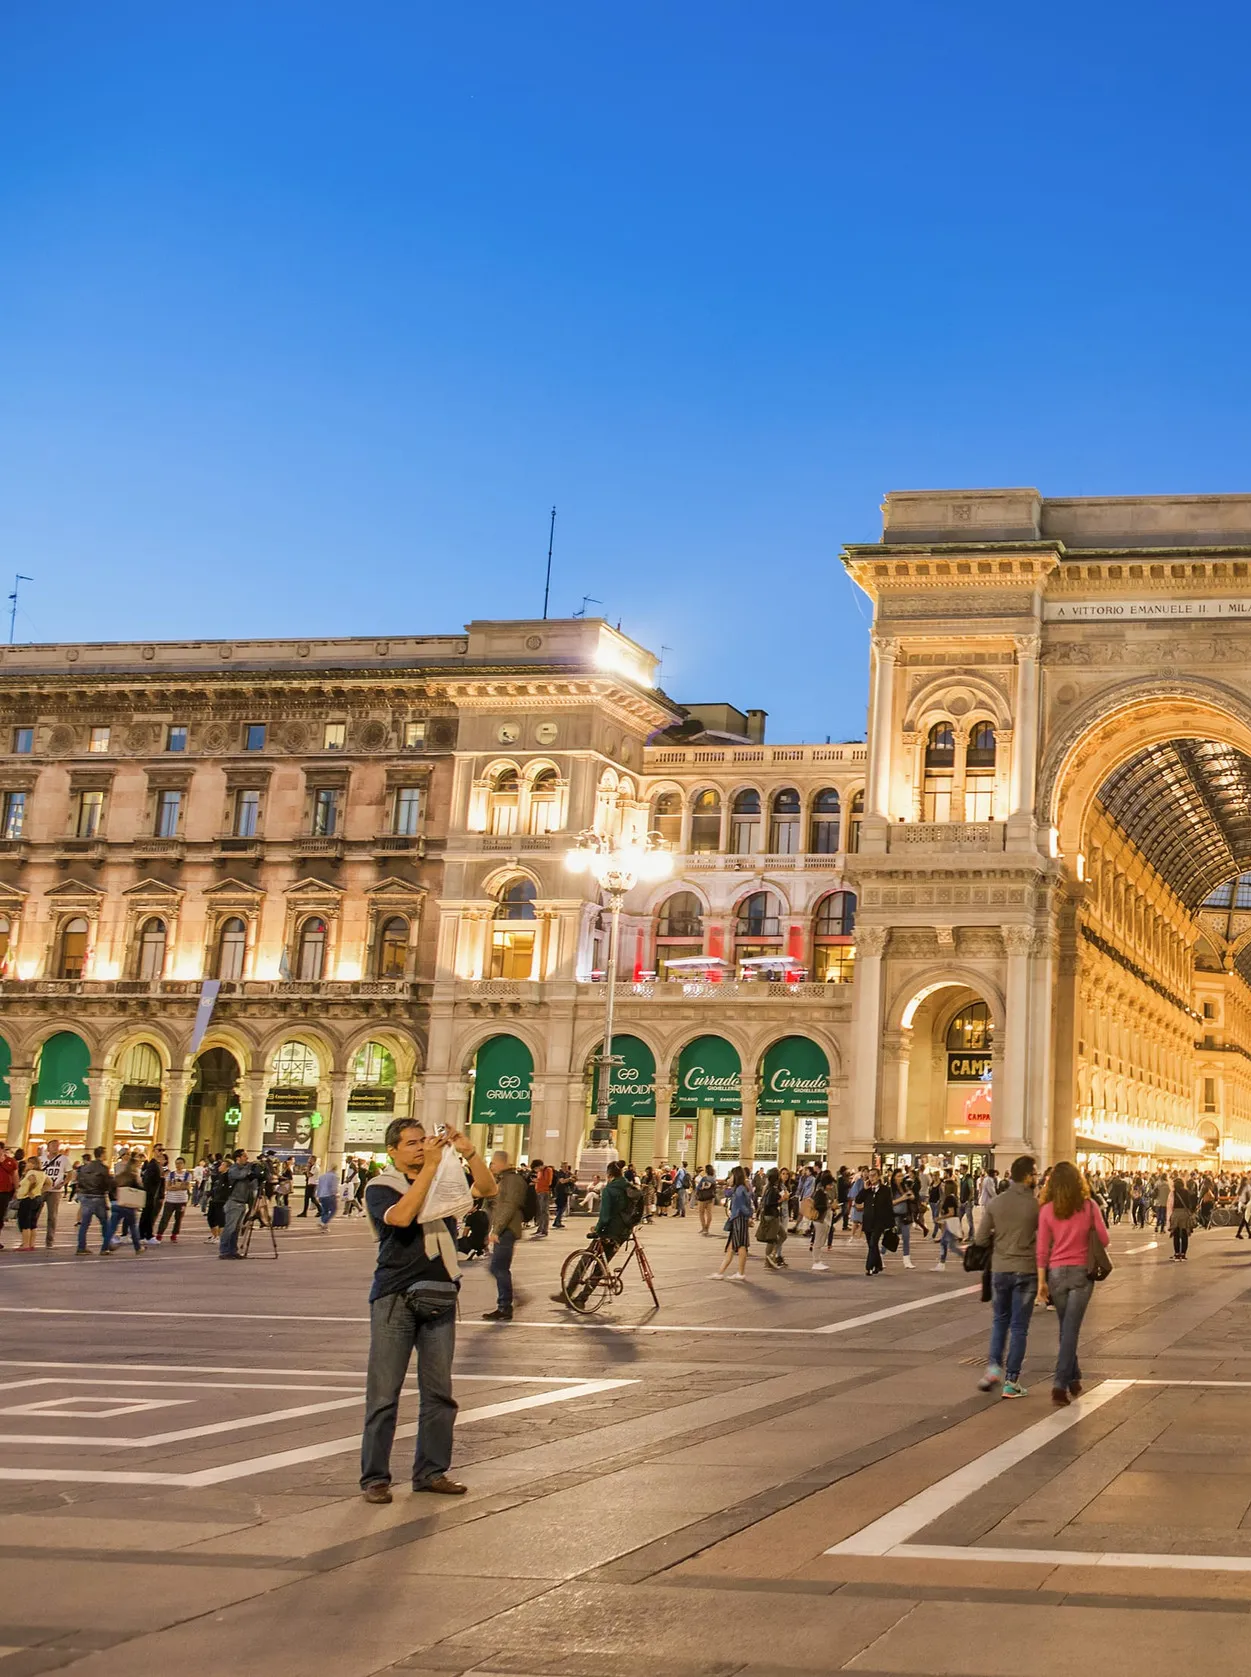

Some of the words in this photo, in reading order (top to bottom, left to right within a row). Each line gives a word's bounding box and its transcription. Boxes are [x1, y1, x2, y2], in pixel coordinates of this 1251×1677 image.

[1058, 608, 1065, 616] A
[1073, 606, 1124, 615] VITTORIO
[1130, 605, 1192, 614] EMANUELE
[684, 1066, 740, 1090] Currado
[770, 1068, 826, 1092] Currado
[486, 1090, 530, 1099] GRIMOLDI
